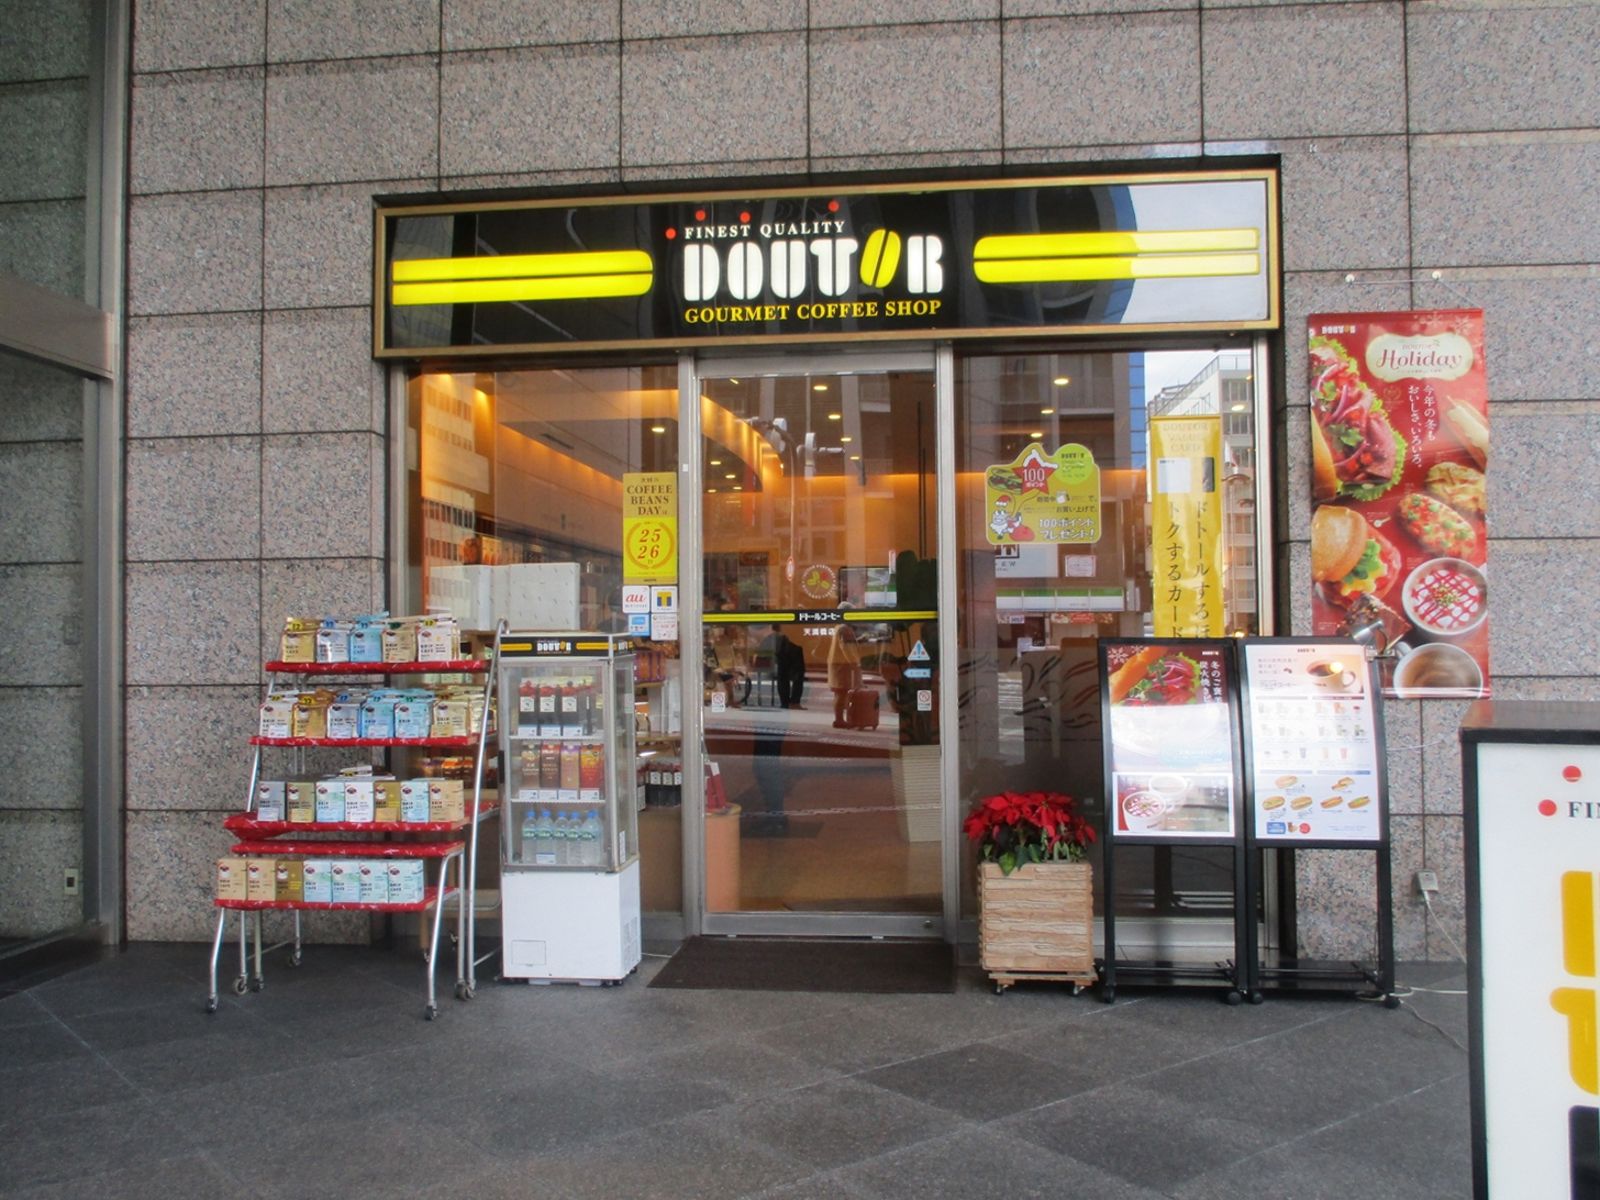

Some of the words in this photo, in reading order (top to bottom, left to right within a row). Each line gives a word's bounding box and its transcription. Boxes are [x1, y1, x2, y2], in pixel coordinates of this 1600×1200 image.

[684, 225, 751, 240] FINEST
[760, 220, 846, 238] QUALITY
[683, 229, 944, 302] DOUTOR
[684, 305, 790, 324] GOURMET
[796, 302, 879, 320] COFFEE
[884, 299, 942, 317] SHOP
[1376, 348, 1462, 370] Holiday
[1423, 384, 1437, 441] 今年の冬も
[1023, 468, 1045, 482] 100
[626, 485, 672, 494] COFFEE
[631, 496, 669, 504] BEANS
[638, 506, 661, 515] DAY
[639, 529, 661, 542] 25
[637, 546, 660, 559] 26
[625, 594, 645, 603] au
[799, 613, 841, 621] ドトールコーヒー
[537, 641, 572, 652] DOUTOR
[1567, 801, 1600, 819] FI
